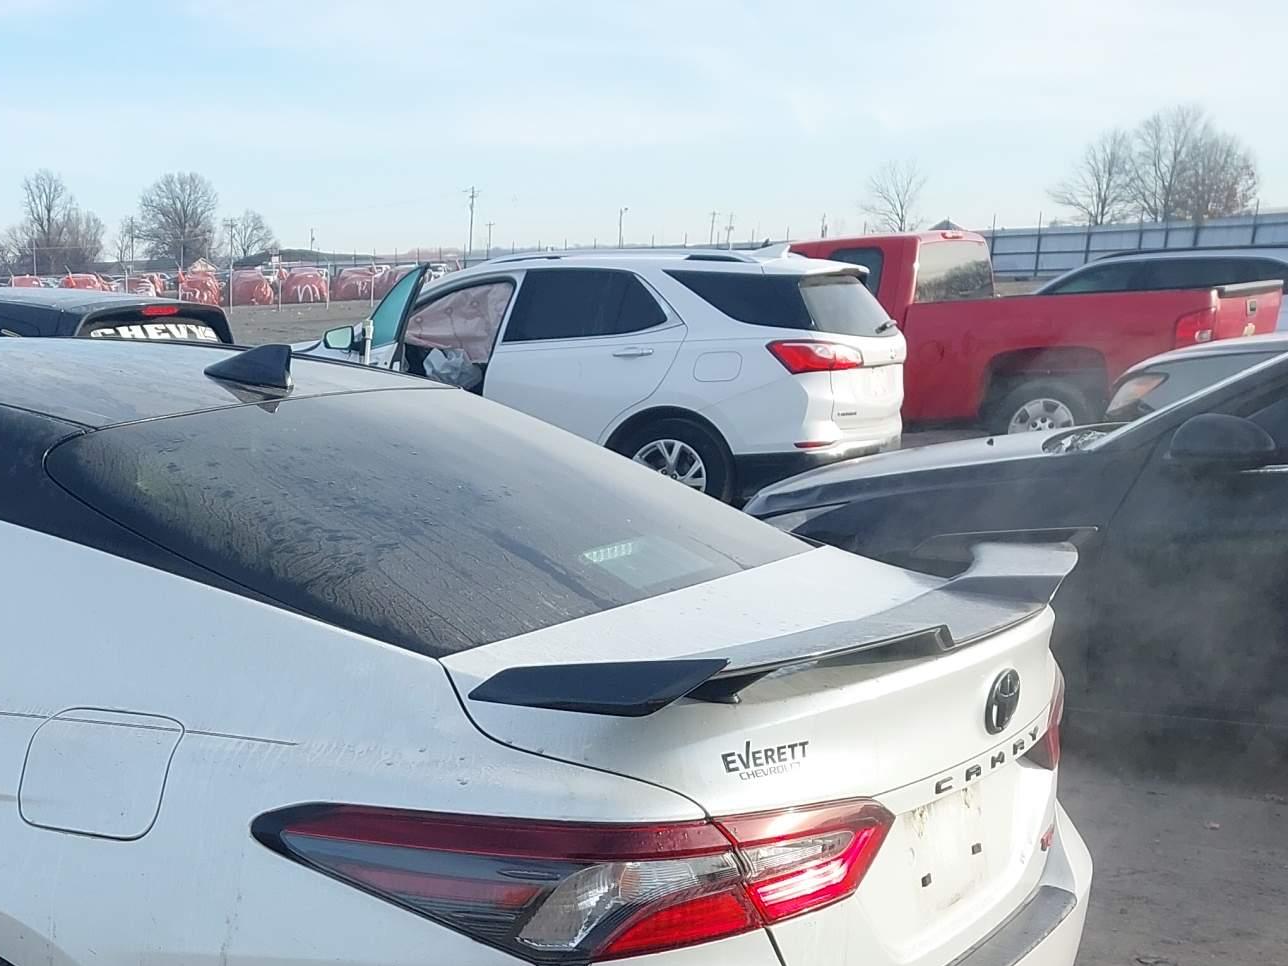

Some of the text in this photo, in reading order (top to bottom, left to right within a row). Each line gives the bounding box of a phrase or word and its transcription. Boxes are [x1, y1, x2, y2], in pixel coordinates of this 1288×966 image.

[90, 323, 218, 342] CHEVY
[721, 740, 809, 773] EVERETT
[935, 725, 1039, 794] CAMRY
